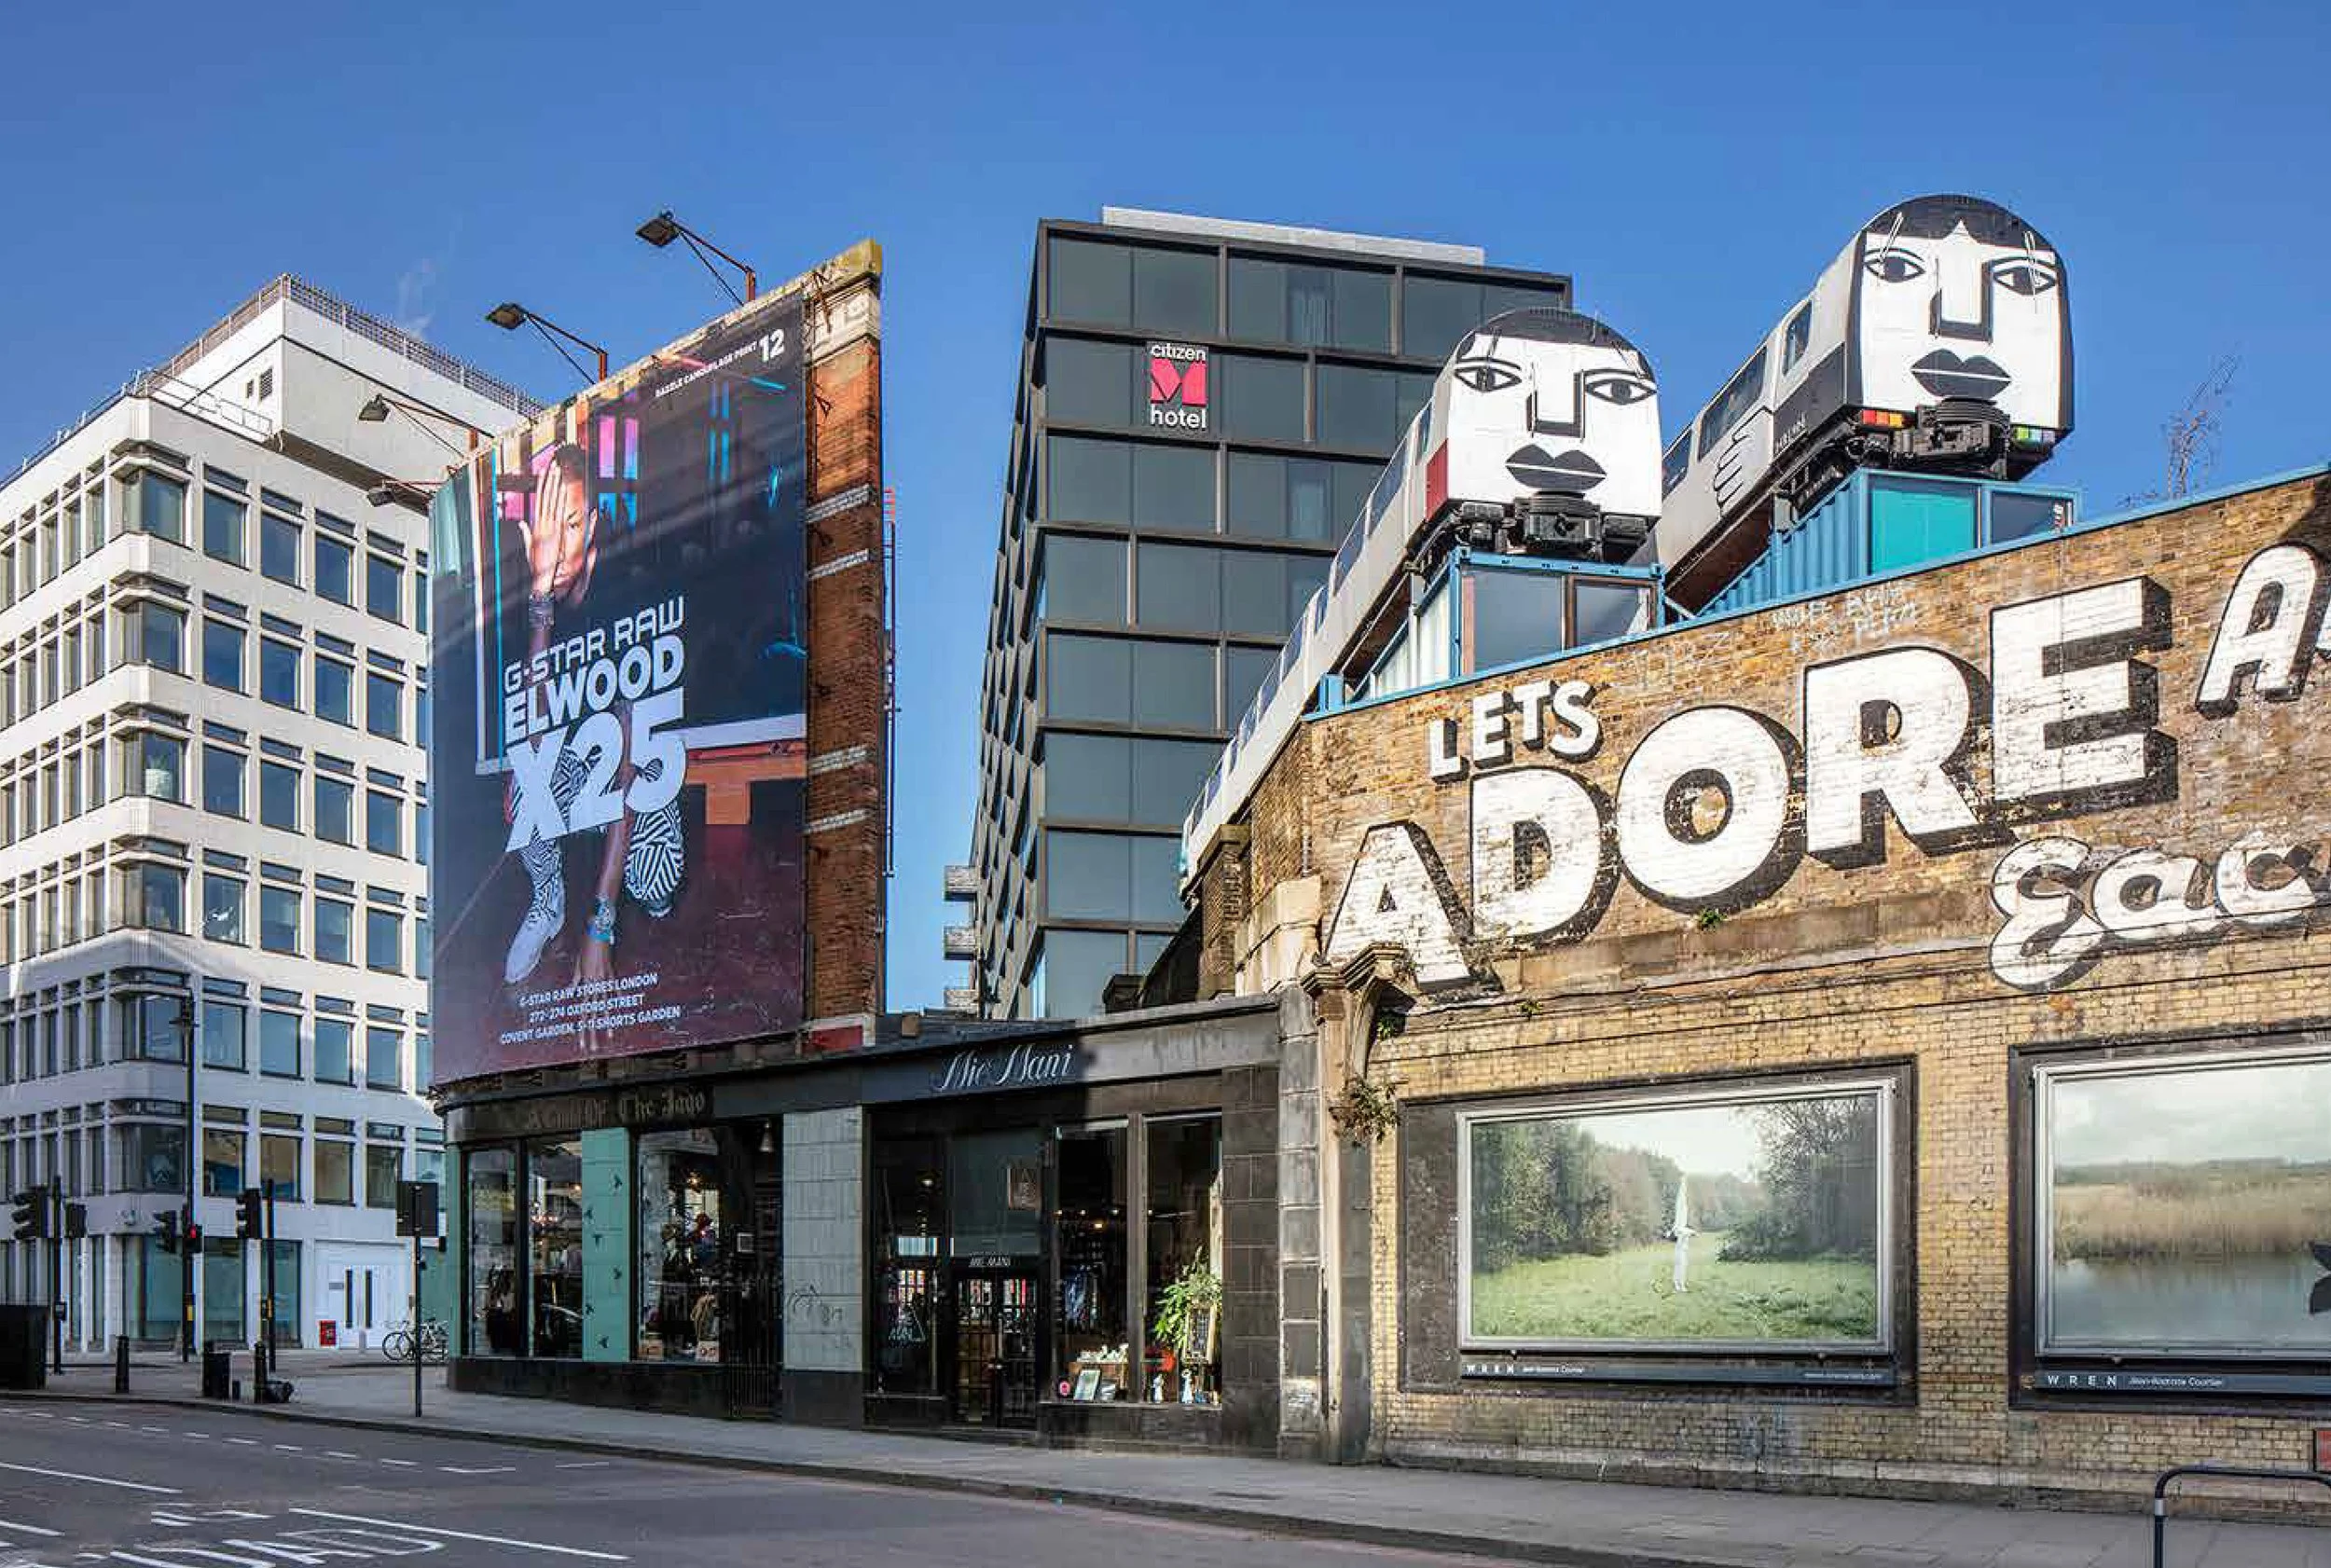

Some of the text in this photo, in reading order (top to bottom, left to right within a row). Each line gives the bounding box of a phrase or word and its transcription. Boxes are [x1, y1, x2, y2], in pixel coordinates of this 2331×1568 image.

[759, 329, 784, 362] 12
[1150, 342, 1207, 361] citizen
[1151, 404, 1207, 429] hotel
[503, 596, 685, 693] G-STAR RAW
[503, 635, 685, 747] ELWOOD
[1429, 680, 1603, 781] LETS
[503, 686, 686, 852] X25
[1322, 575, 2178, 992] ADORE
[553, 987, 575, 1002] RAW
[575, 980, 614, 998] STORES
[614, 971, 658, 991] LONDON
[566, 1001, 607, 1017] OXFORD
[607, 994, 645, 1010] STREET
[500, 1030, 534, 1044] COVENT
[595, 1013, 637, 1030] SHORTS
